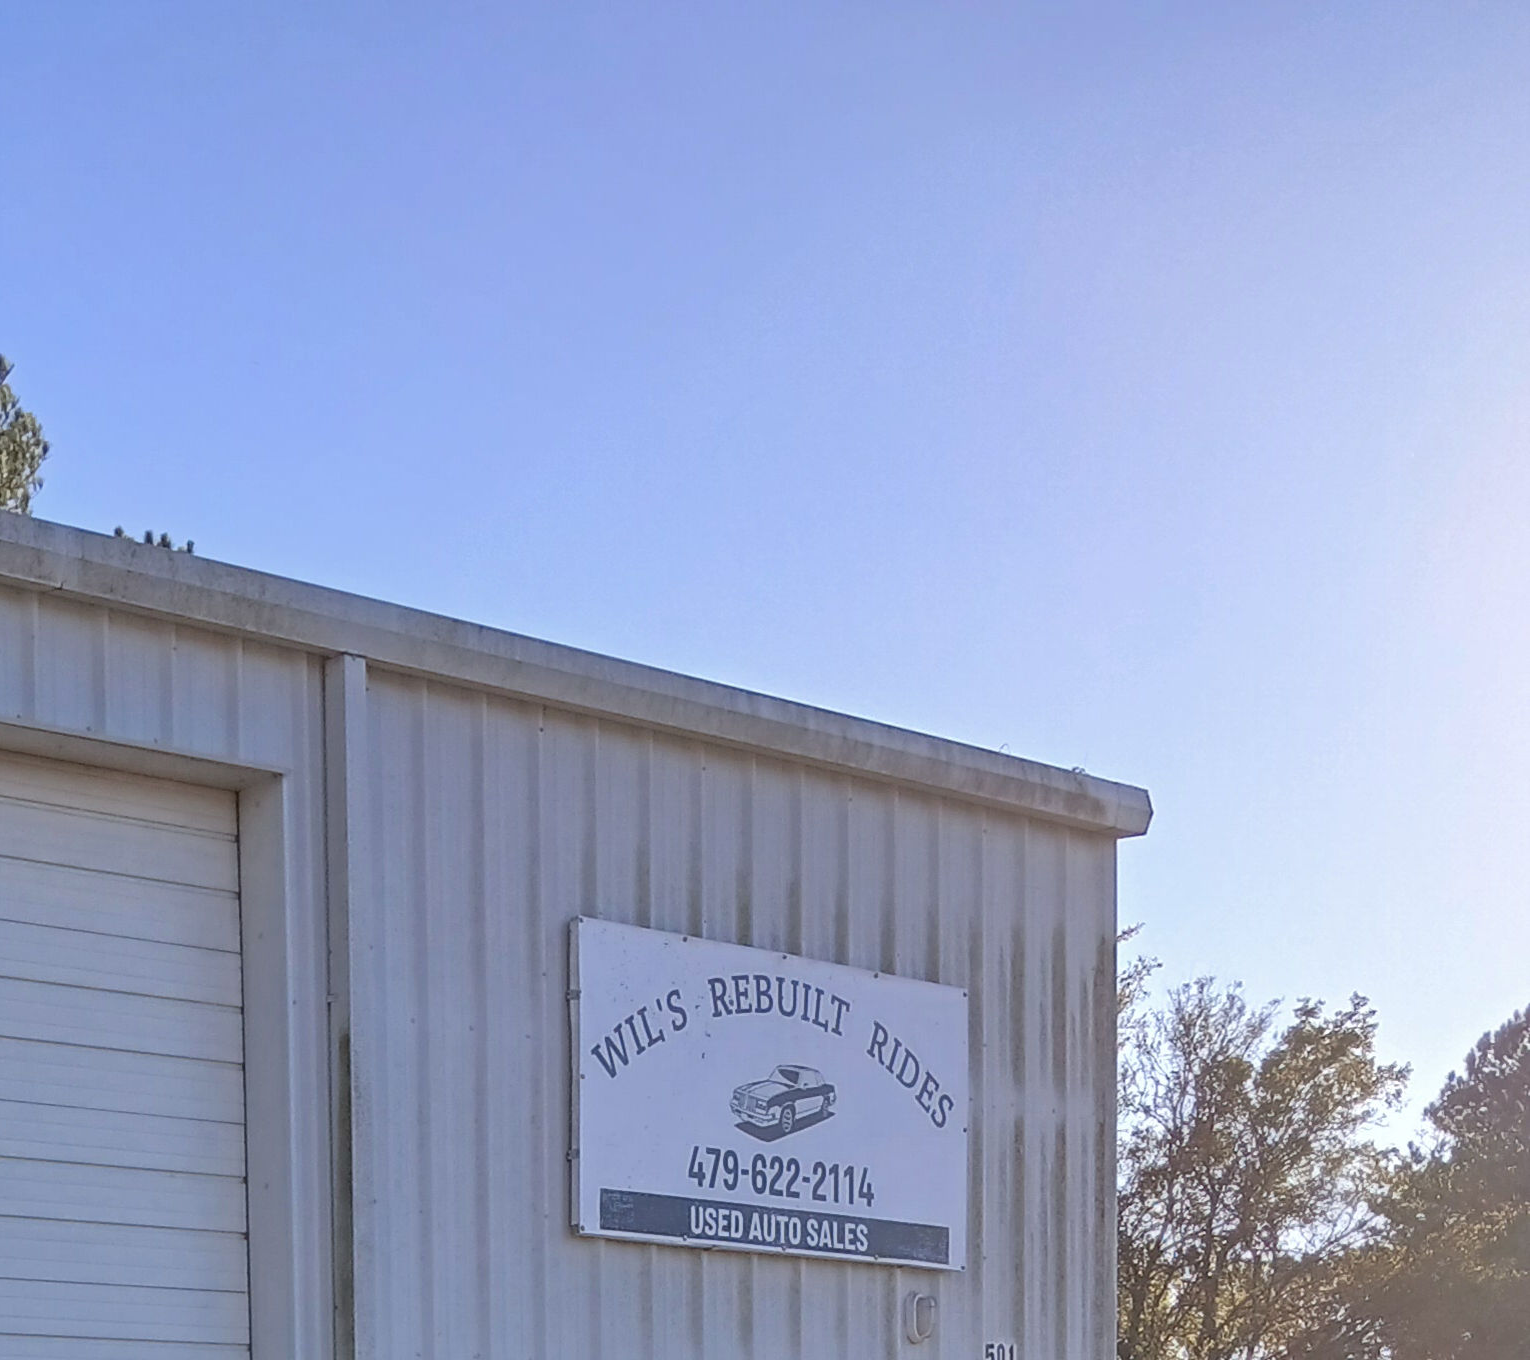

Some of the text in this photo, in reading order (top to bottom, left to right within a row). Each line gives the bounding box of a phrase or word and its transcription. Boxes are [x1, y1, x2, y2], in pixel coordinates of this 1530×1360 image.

[590, 974, 954, 1129] WIL'S REBUILT RIDES
[688, 1145, 875, 1208] 479-622-2114
[690, 1205, 869, 1251] USED AUTO SALES
